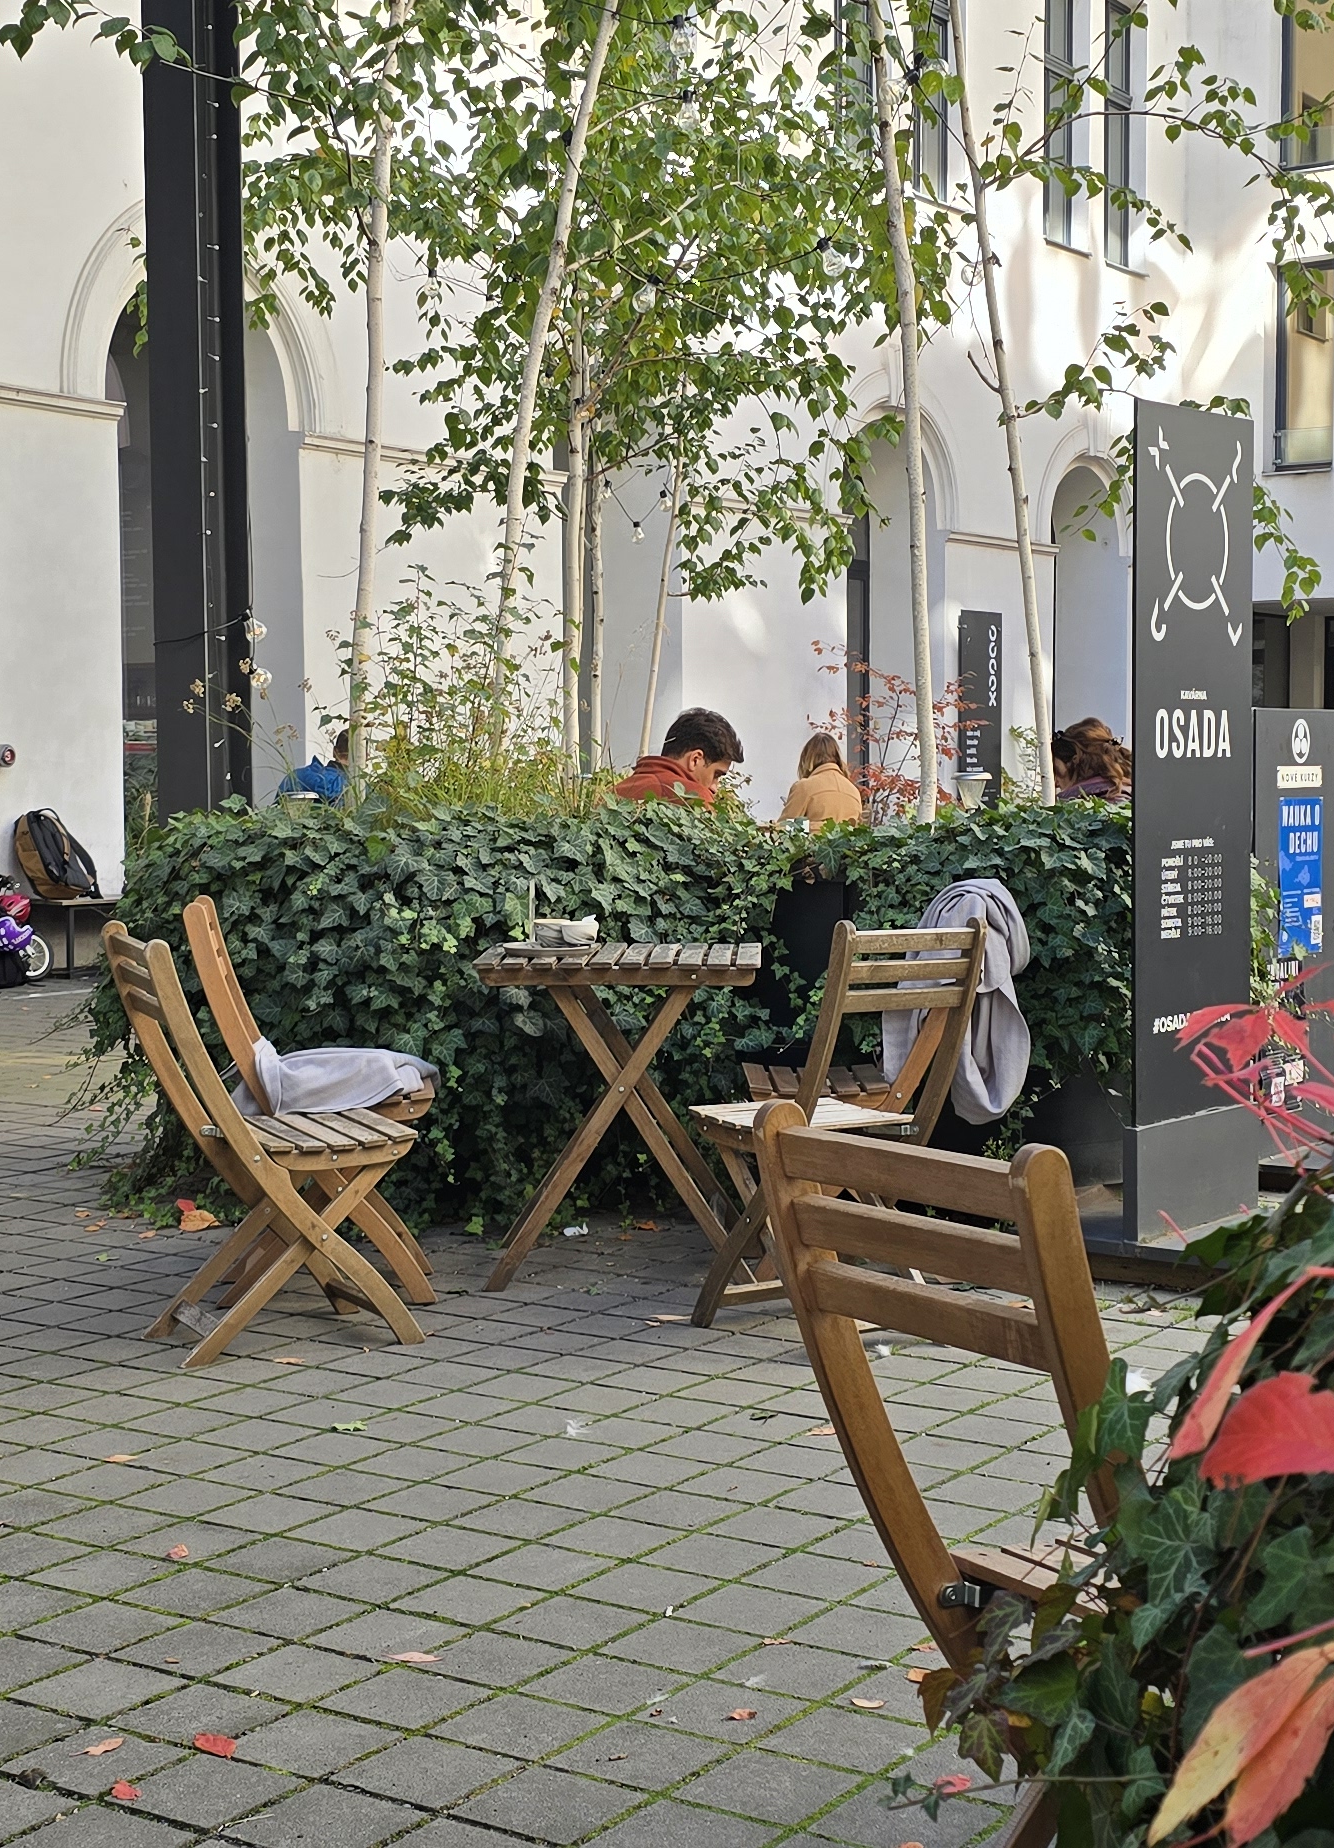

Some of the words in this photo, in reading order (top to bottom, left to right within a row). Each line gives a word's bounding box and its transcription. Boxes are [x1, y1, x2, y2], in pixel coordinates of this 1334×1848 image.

[1155, 708, 1231, 759] OSADA
[1281, 770, 1298, 783] NOVÉ
[1300, 773, 1319, 783] KURZY
[1282, 804, 1312, 827] NAUKA
[1314, 804, 1320, 826] O
[1289, 831, 1319, 854] DECHU
